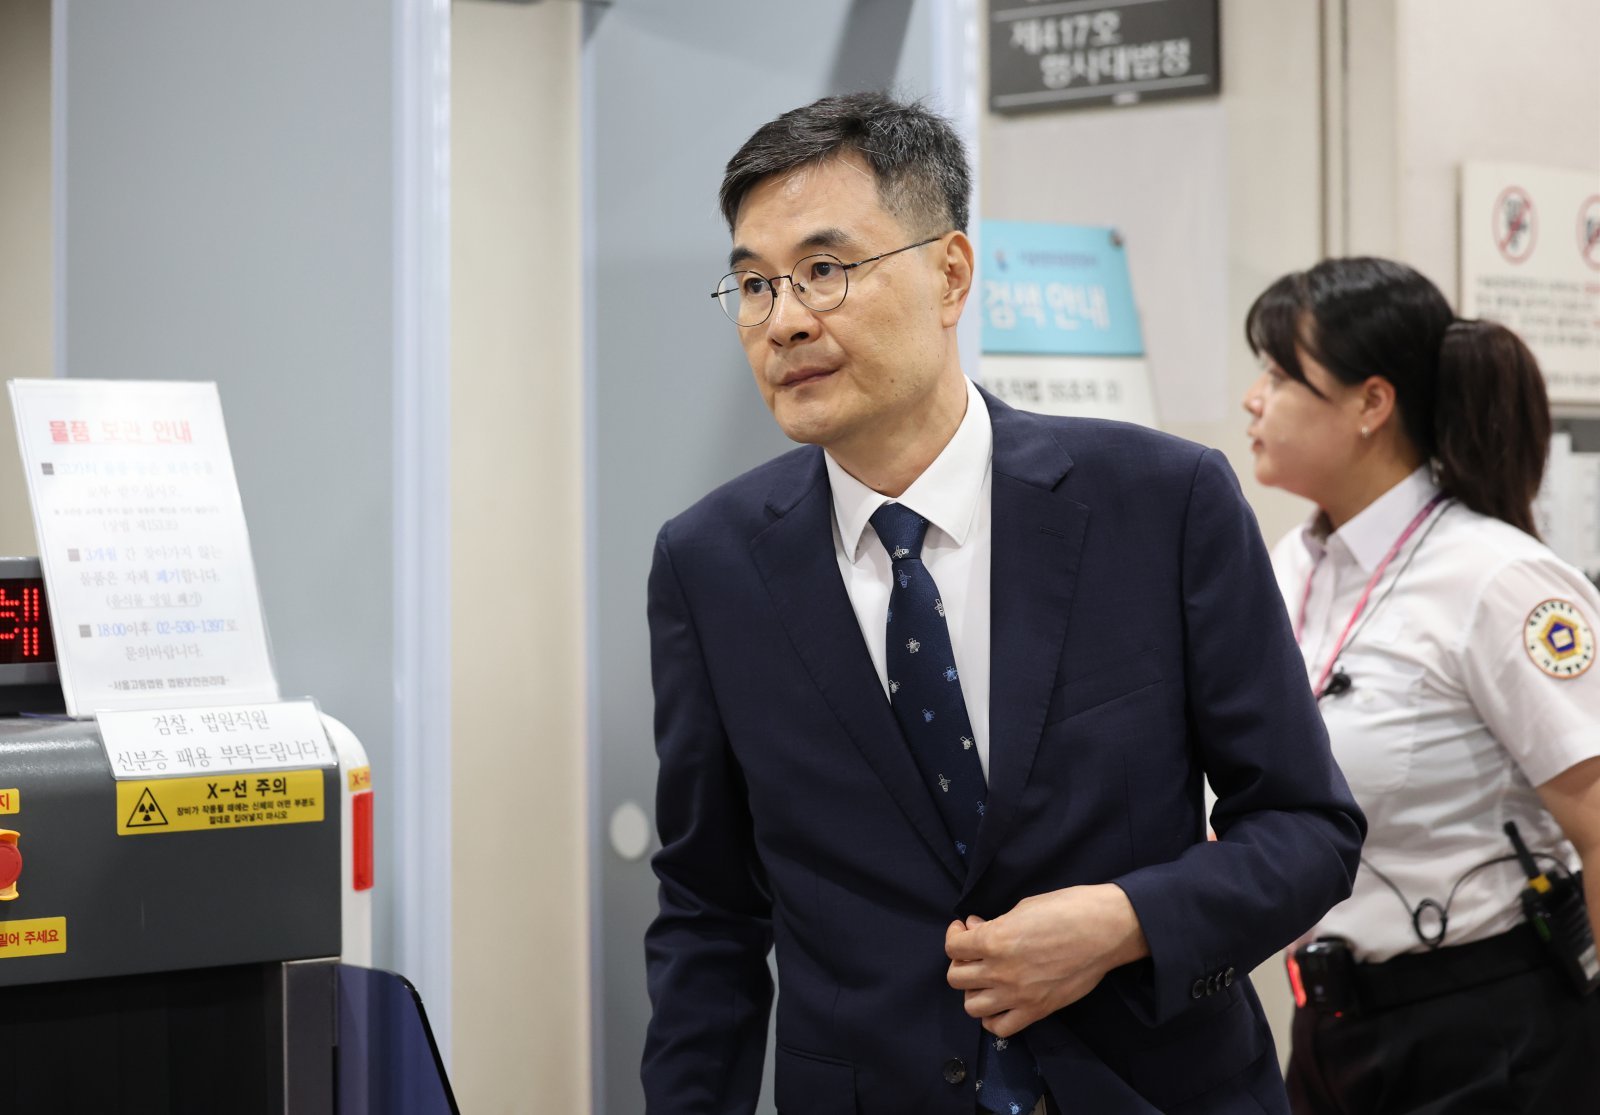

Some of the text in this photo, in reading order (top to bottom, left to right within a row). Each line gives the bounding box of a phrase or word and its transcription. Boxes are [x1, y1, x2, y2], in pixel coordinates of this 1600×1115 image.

[1010, 10, 1121, 55] 제417호
[1039, 38, 1191, 89] 형사대법정
[1047, 280, 1110, 331] 안내
[49, 419, 193, 443] 물품 보관 안내
[85, 545, 118, 562] 3개월
[97, 620, 152, 637] 18:00이후
[125, 643, 204, 662] 문의바랍니다.
[152, 709, 271, 737] 검찰, 법원직원
[117, 750, 169, 772] 신분증
[175, 745, 213, 768] 패용
[207, 777, 288, 799] X-선 주의
[24, 929, 59, 946] 주세요
